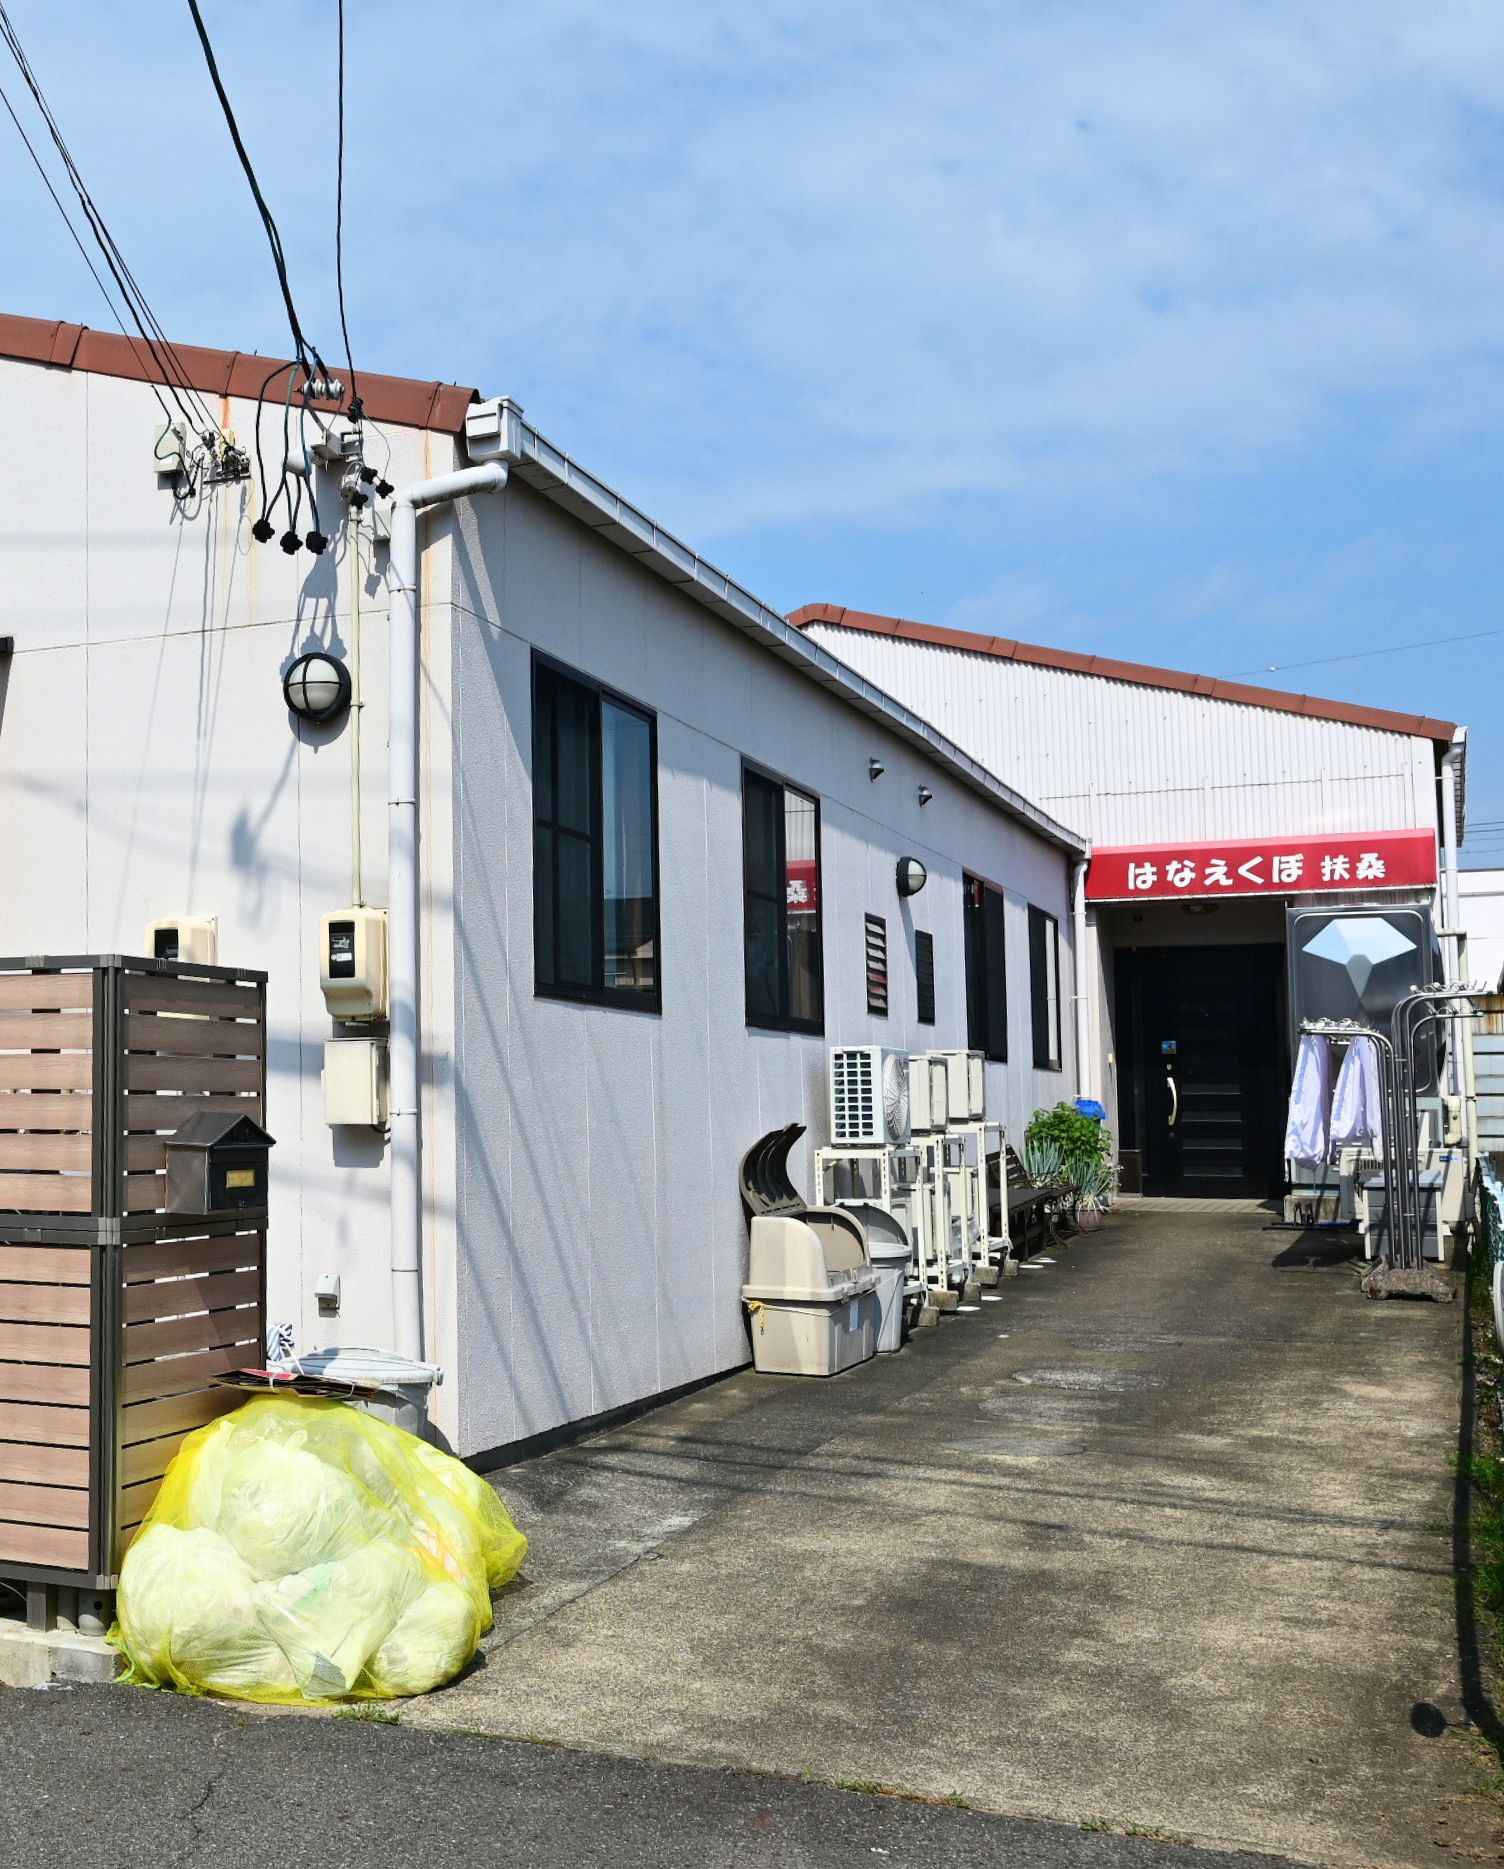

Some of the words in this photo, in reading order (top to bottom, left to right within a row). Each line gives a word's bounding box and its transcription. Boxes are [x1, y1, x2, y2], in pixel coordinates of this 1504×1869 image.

[1127, 855, 1304, 890] はなえくぼ
[1320, 852, 1387, 882] 扶桑
